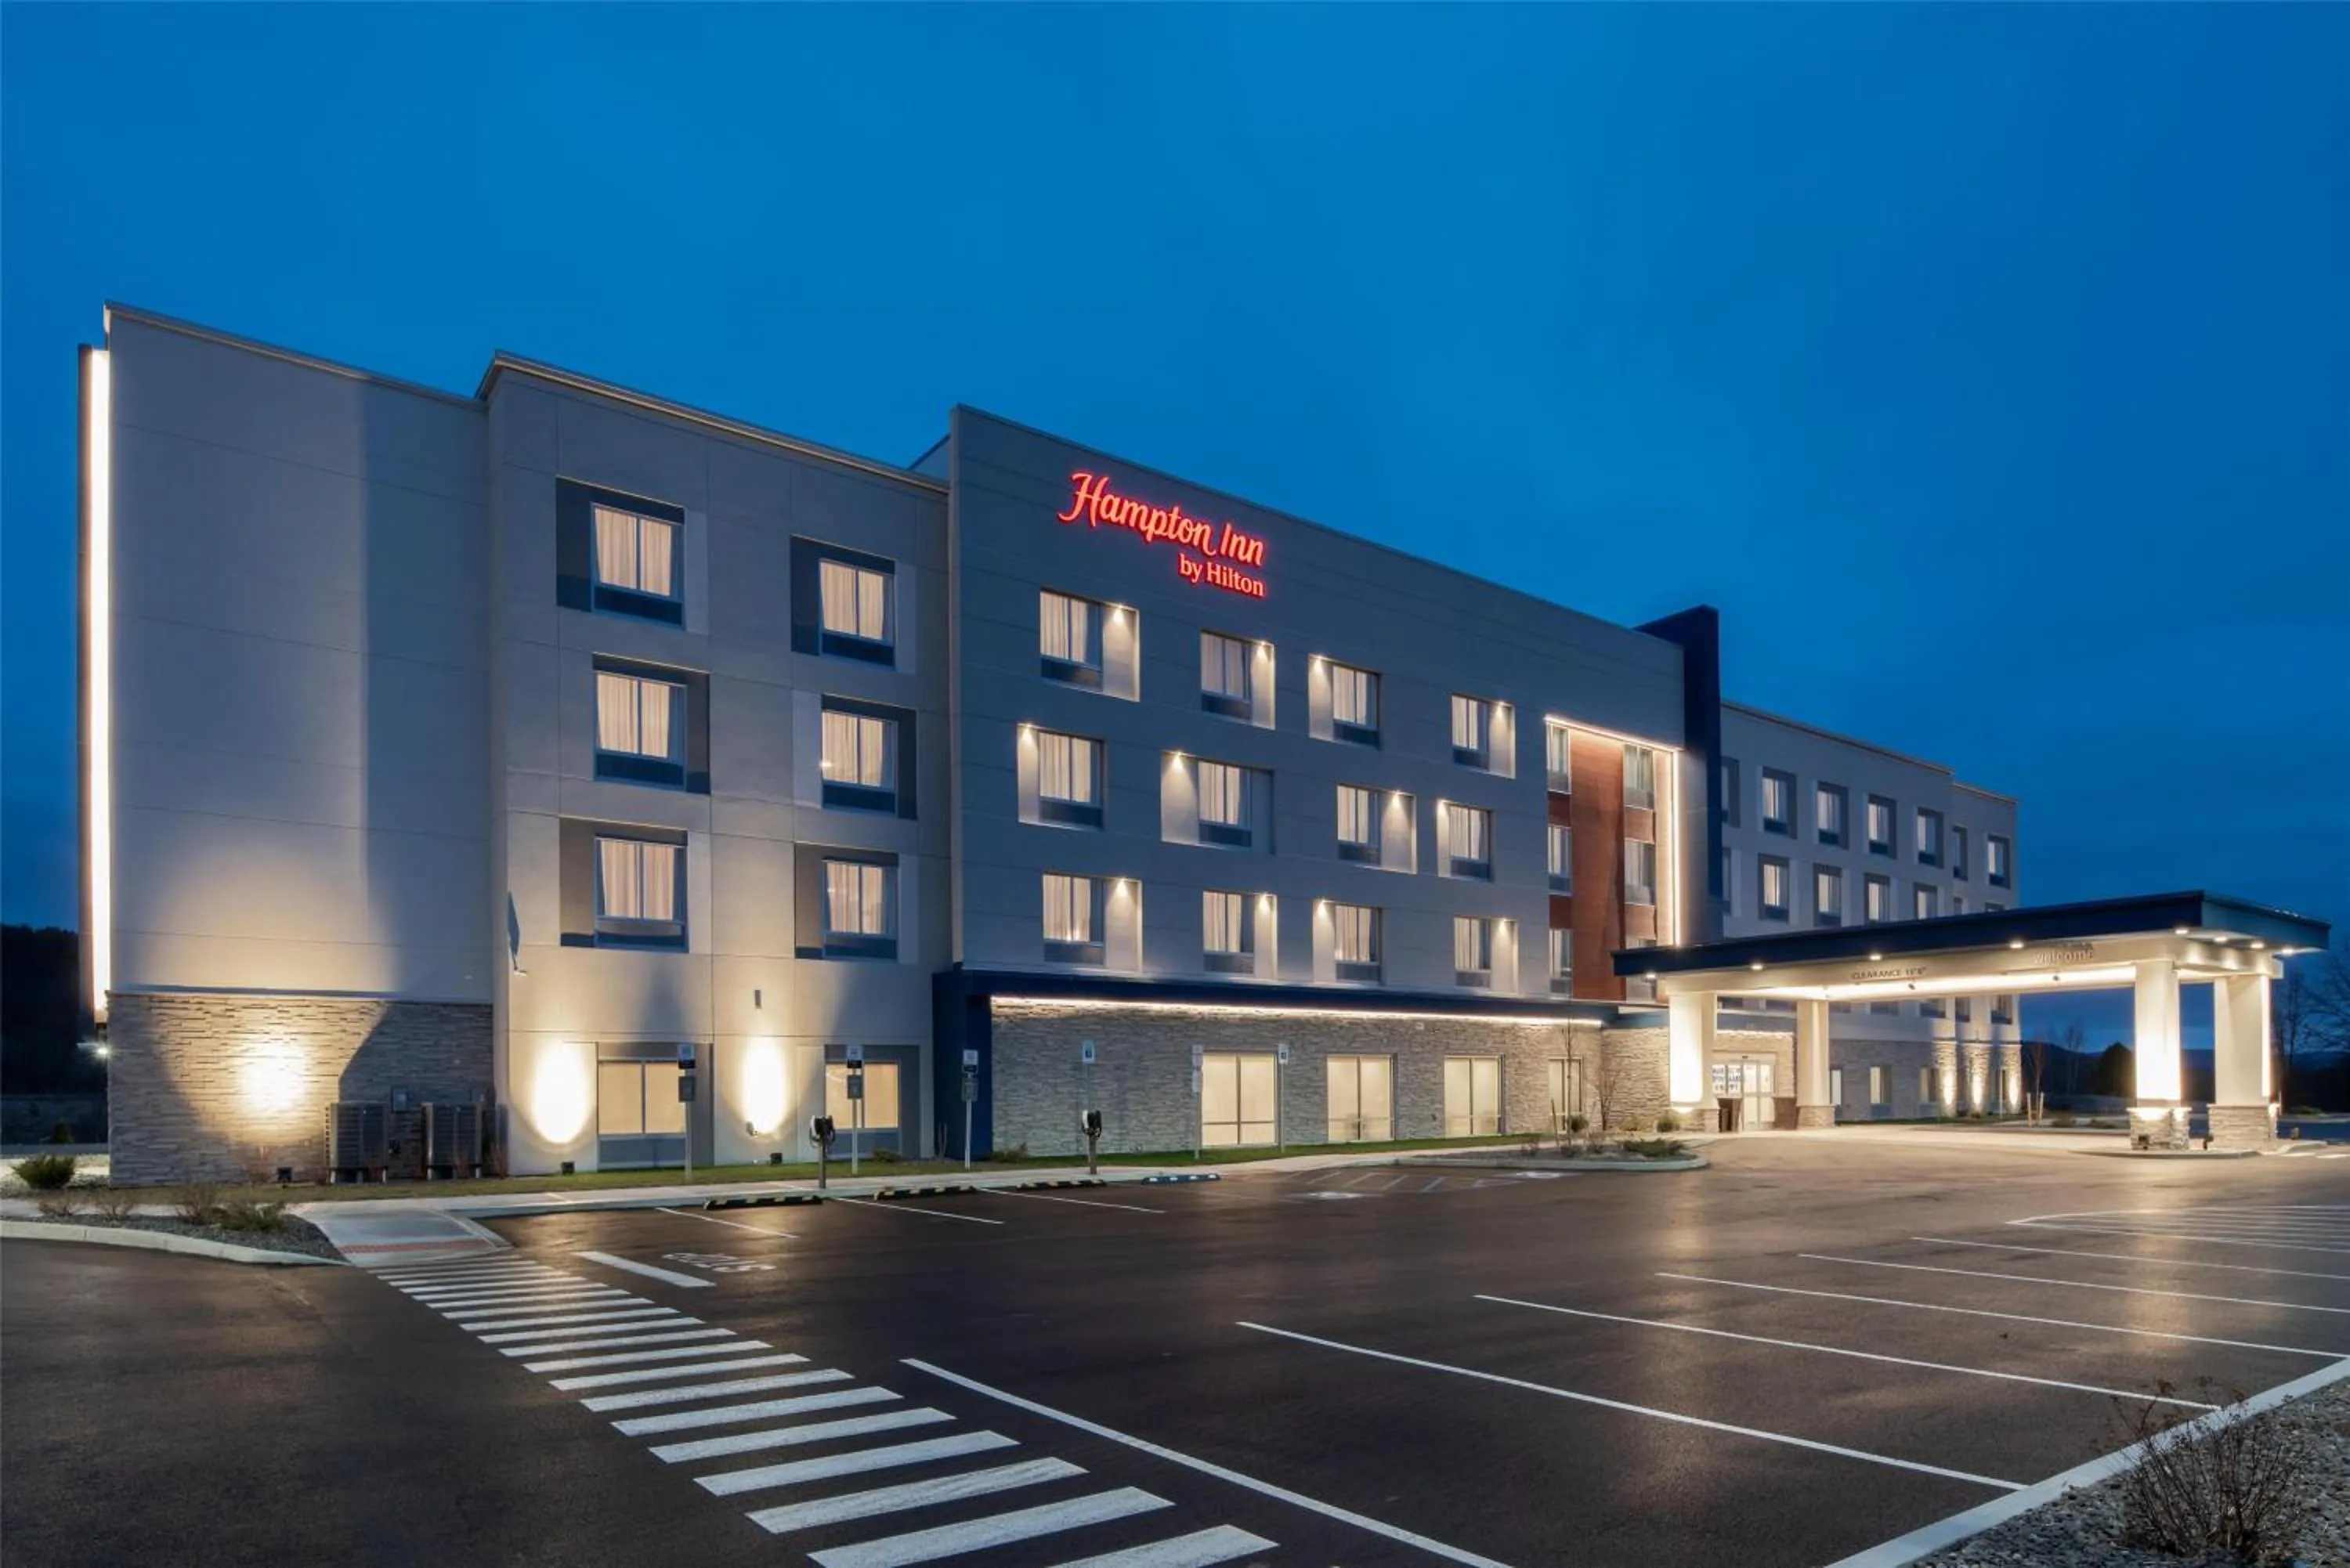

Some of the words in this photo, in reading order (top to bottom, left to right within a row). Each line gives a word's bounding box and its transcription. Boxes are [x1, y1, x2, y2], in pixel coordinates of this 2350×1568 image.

[1058, 472, 1217, 556] Hampton
[1219, 522, 1264, 566] Inn
[1179, 553, 1203, 583] by
[1206, 561, 1265, 598] Hilton
